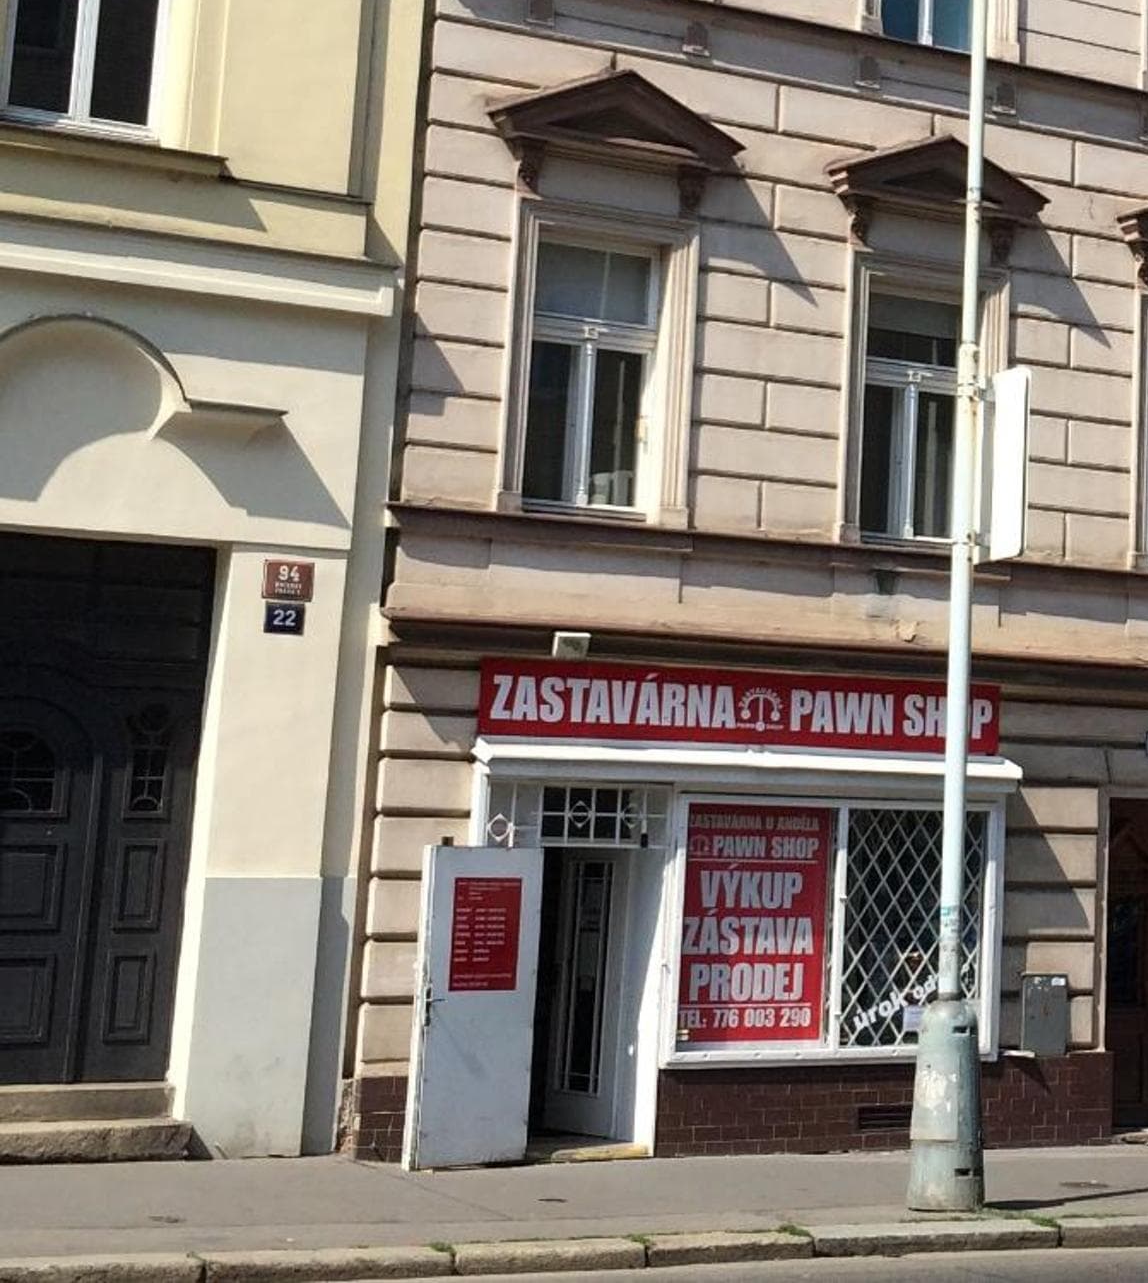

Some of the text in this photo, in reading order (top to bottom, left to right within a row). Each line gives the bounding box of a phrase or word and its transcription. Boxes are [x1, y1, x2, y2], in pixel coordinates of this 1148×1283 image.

[278, 565, 300, 582] 94
[272, 609, 297, 626] 22
[490, 673, 993, 739] ZASTAVÁRNA PAWN SHP
[712, 836, 819, 859] PAWN SHOP
[701, 864, 802, 909] VÝKUP
[682, 909, 813, 955] ZÁSTAVA
[688, 963, 804, 1002] PRODEJ
[679, 1008, 811, 1028] TEL: 776 003 290
